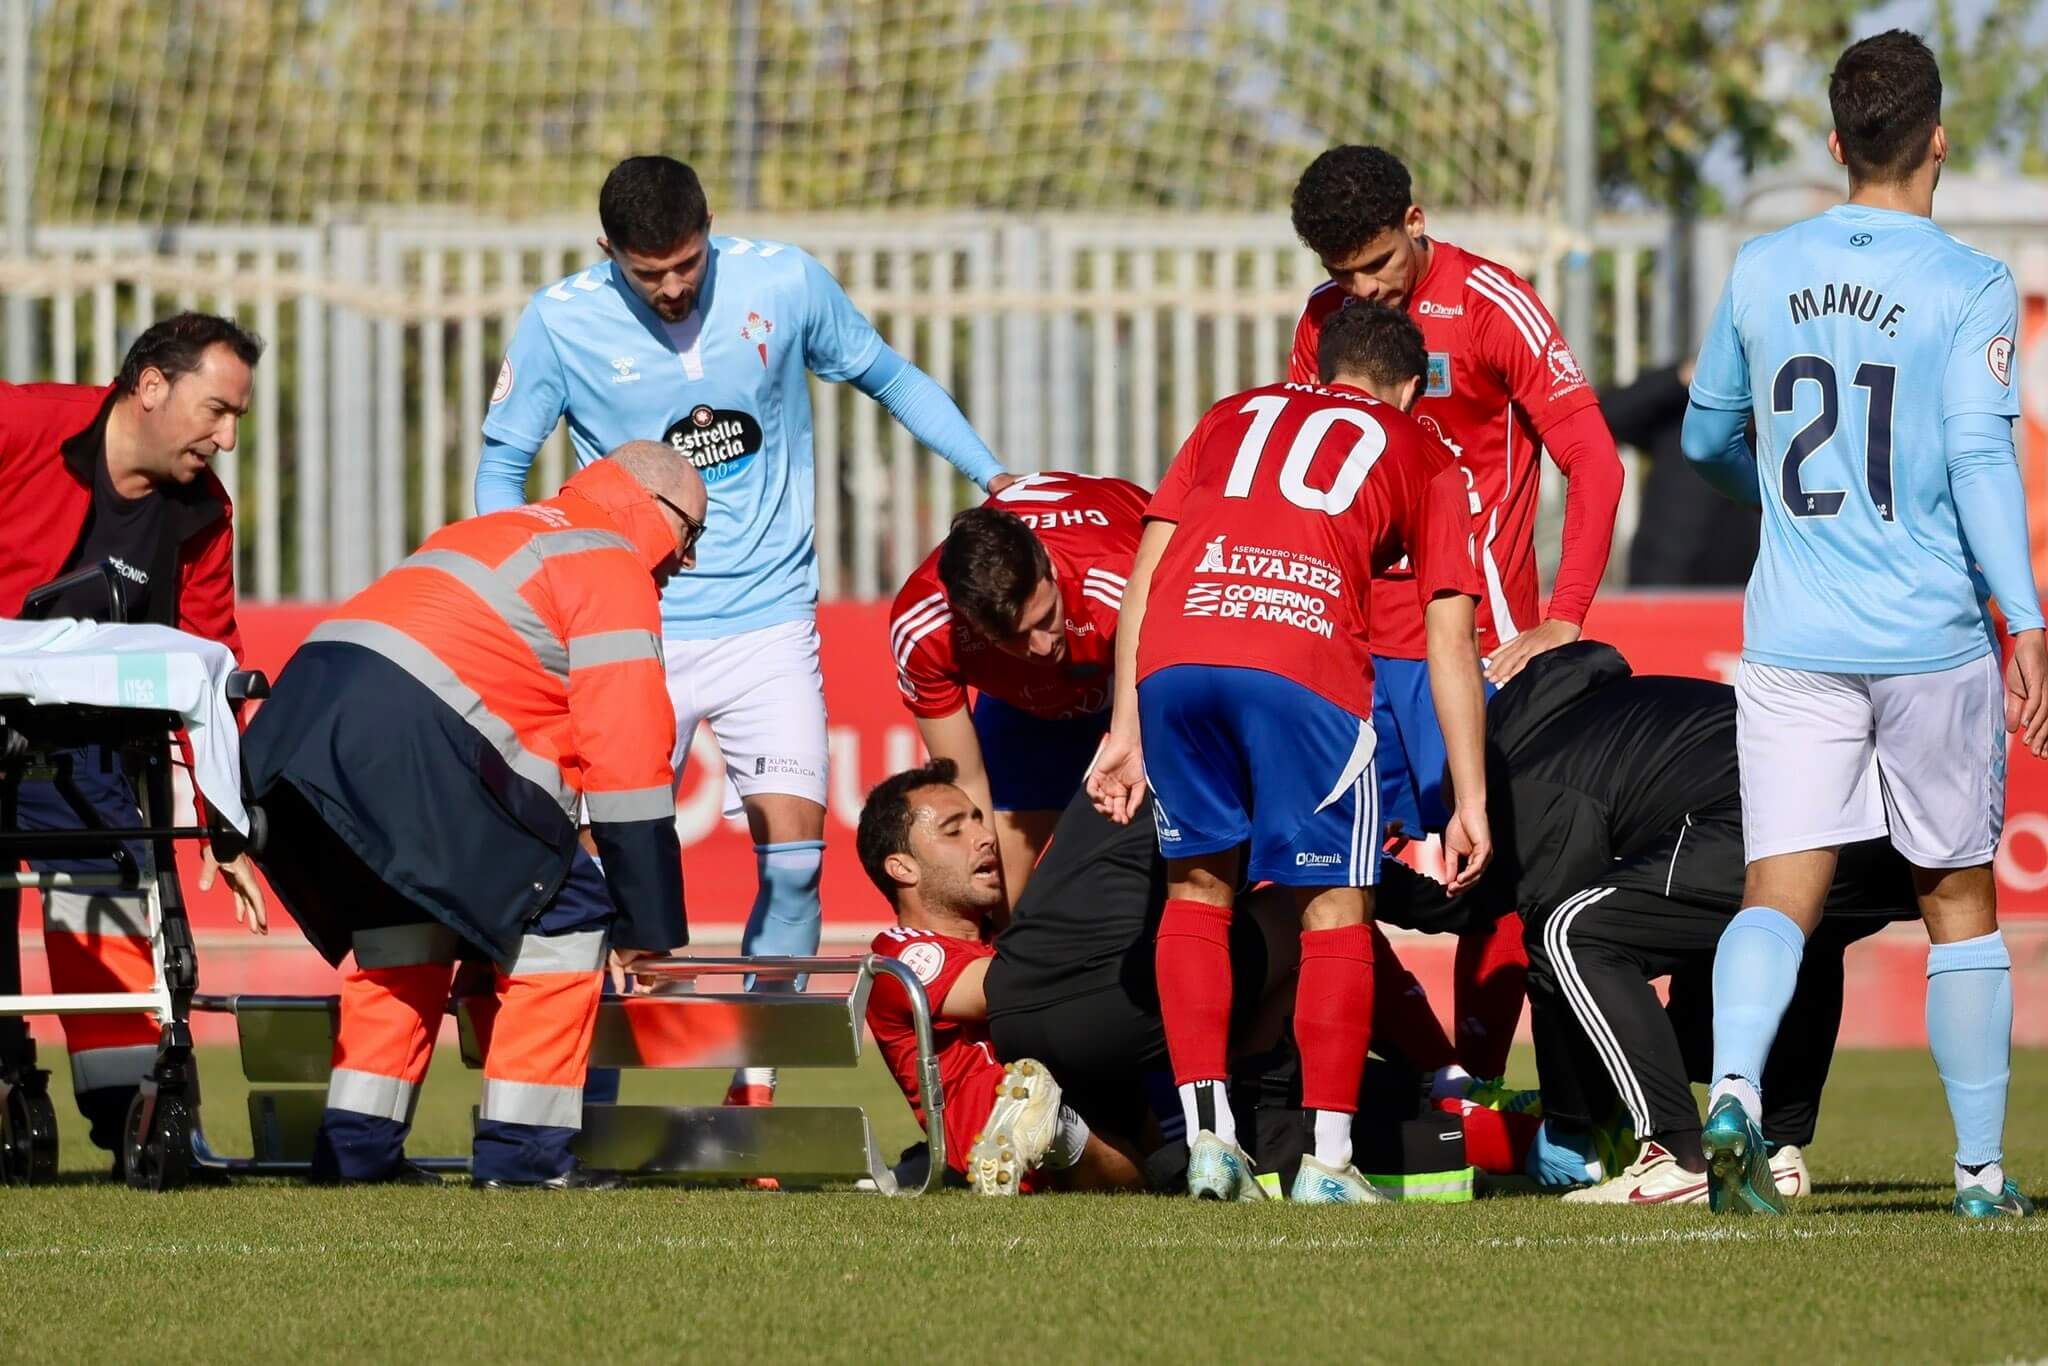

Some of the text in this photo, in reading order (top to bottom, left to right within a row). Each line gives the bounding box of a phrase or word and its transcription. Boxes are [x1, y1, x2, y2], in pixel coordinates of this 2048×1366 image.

[1788, 285, 1907, 339] MANU F.
[671, 420, 744, 452] Estrella
[1772, 353, 1897, 523] 21
[1223, 395, 1388, 516] 10
[1194, 535, 1342, 599] ÁLVAREZ
[1232, 545, 1291, 559] ASERRADERO
[1291, 552, 1298, 561] Y
[1219, 600, 1249, 619] DE
[1224, 583, 1326, 616] GOBIERNO
[767, 758, 799, 766] XUNTA
[768, 765, 816, 777] DE GALICIA
[1306, 852, 1342, 864] Chemik
